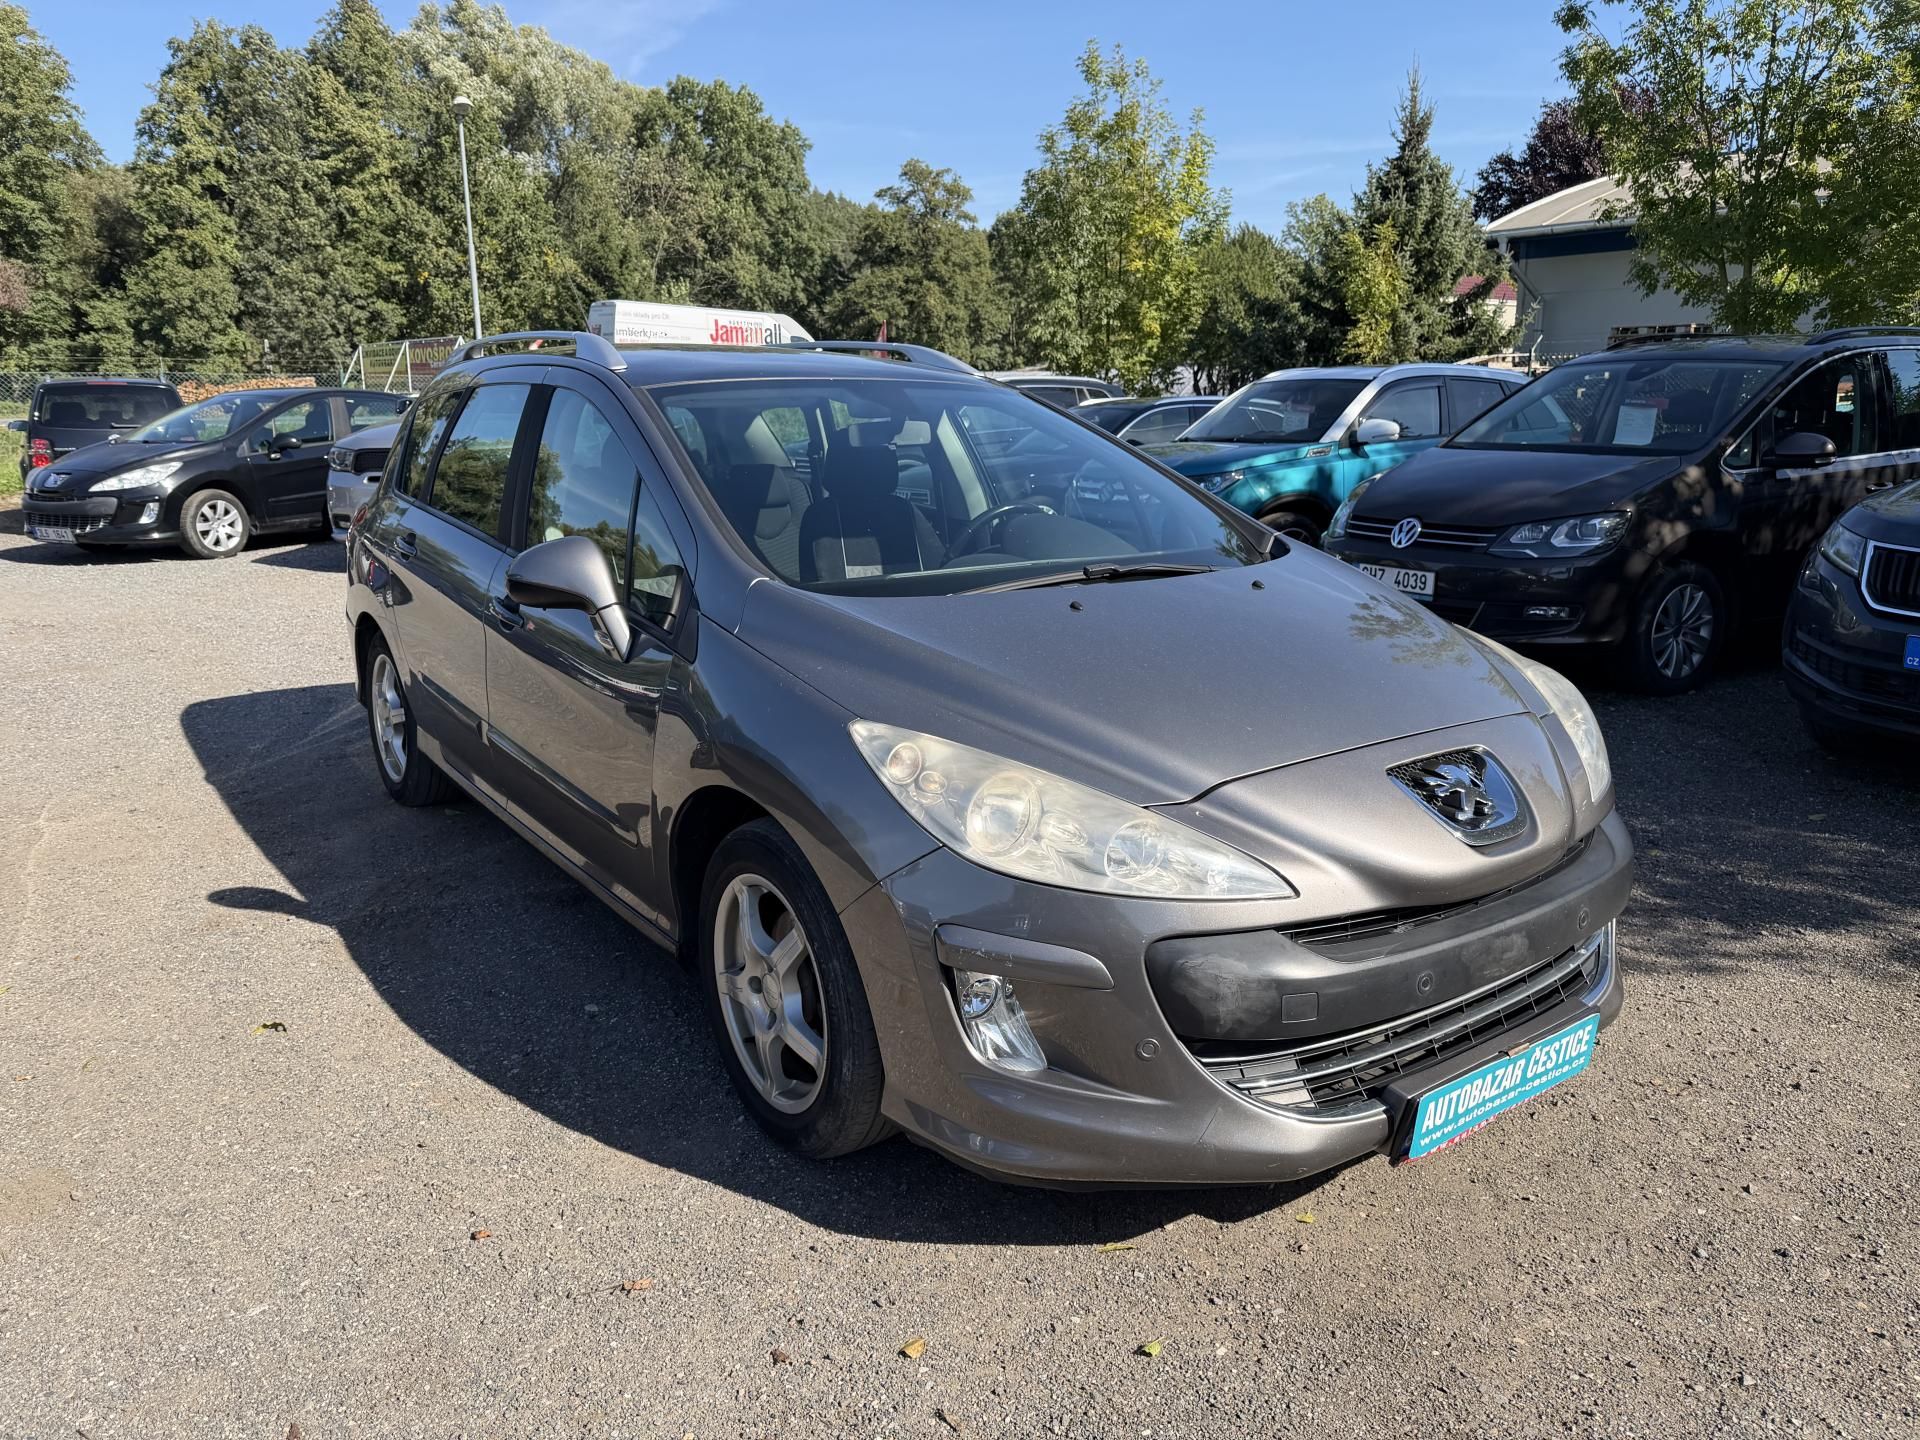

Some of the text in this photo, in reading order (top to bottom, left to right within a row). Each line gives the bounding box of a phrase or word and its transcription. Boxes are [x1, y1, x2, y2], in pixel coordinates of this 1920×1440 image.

[410, 343, 455, 364] KOVOŠRO
[1394, 571, 1427, 591] 4039
[1907, 656, 1920, 666] CZ
[1421, 1058, 1526, 1134] AUTOBAZAR
[1526, 1024, 1593, 1079] ČESTICE
[1419, 1055, 1586, 1147] www.autobazar-cestice.cz
